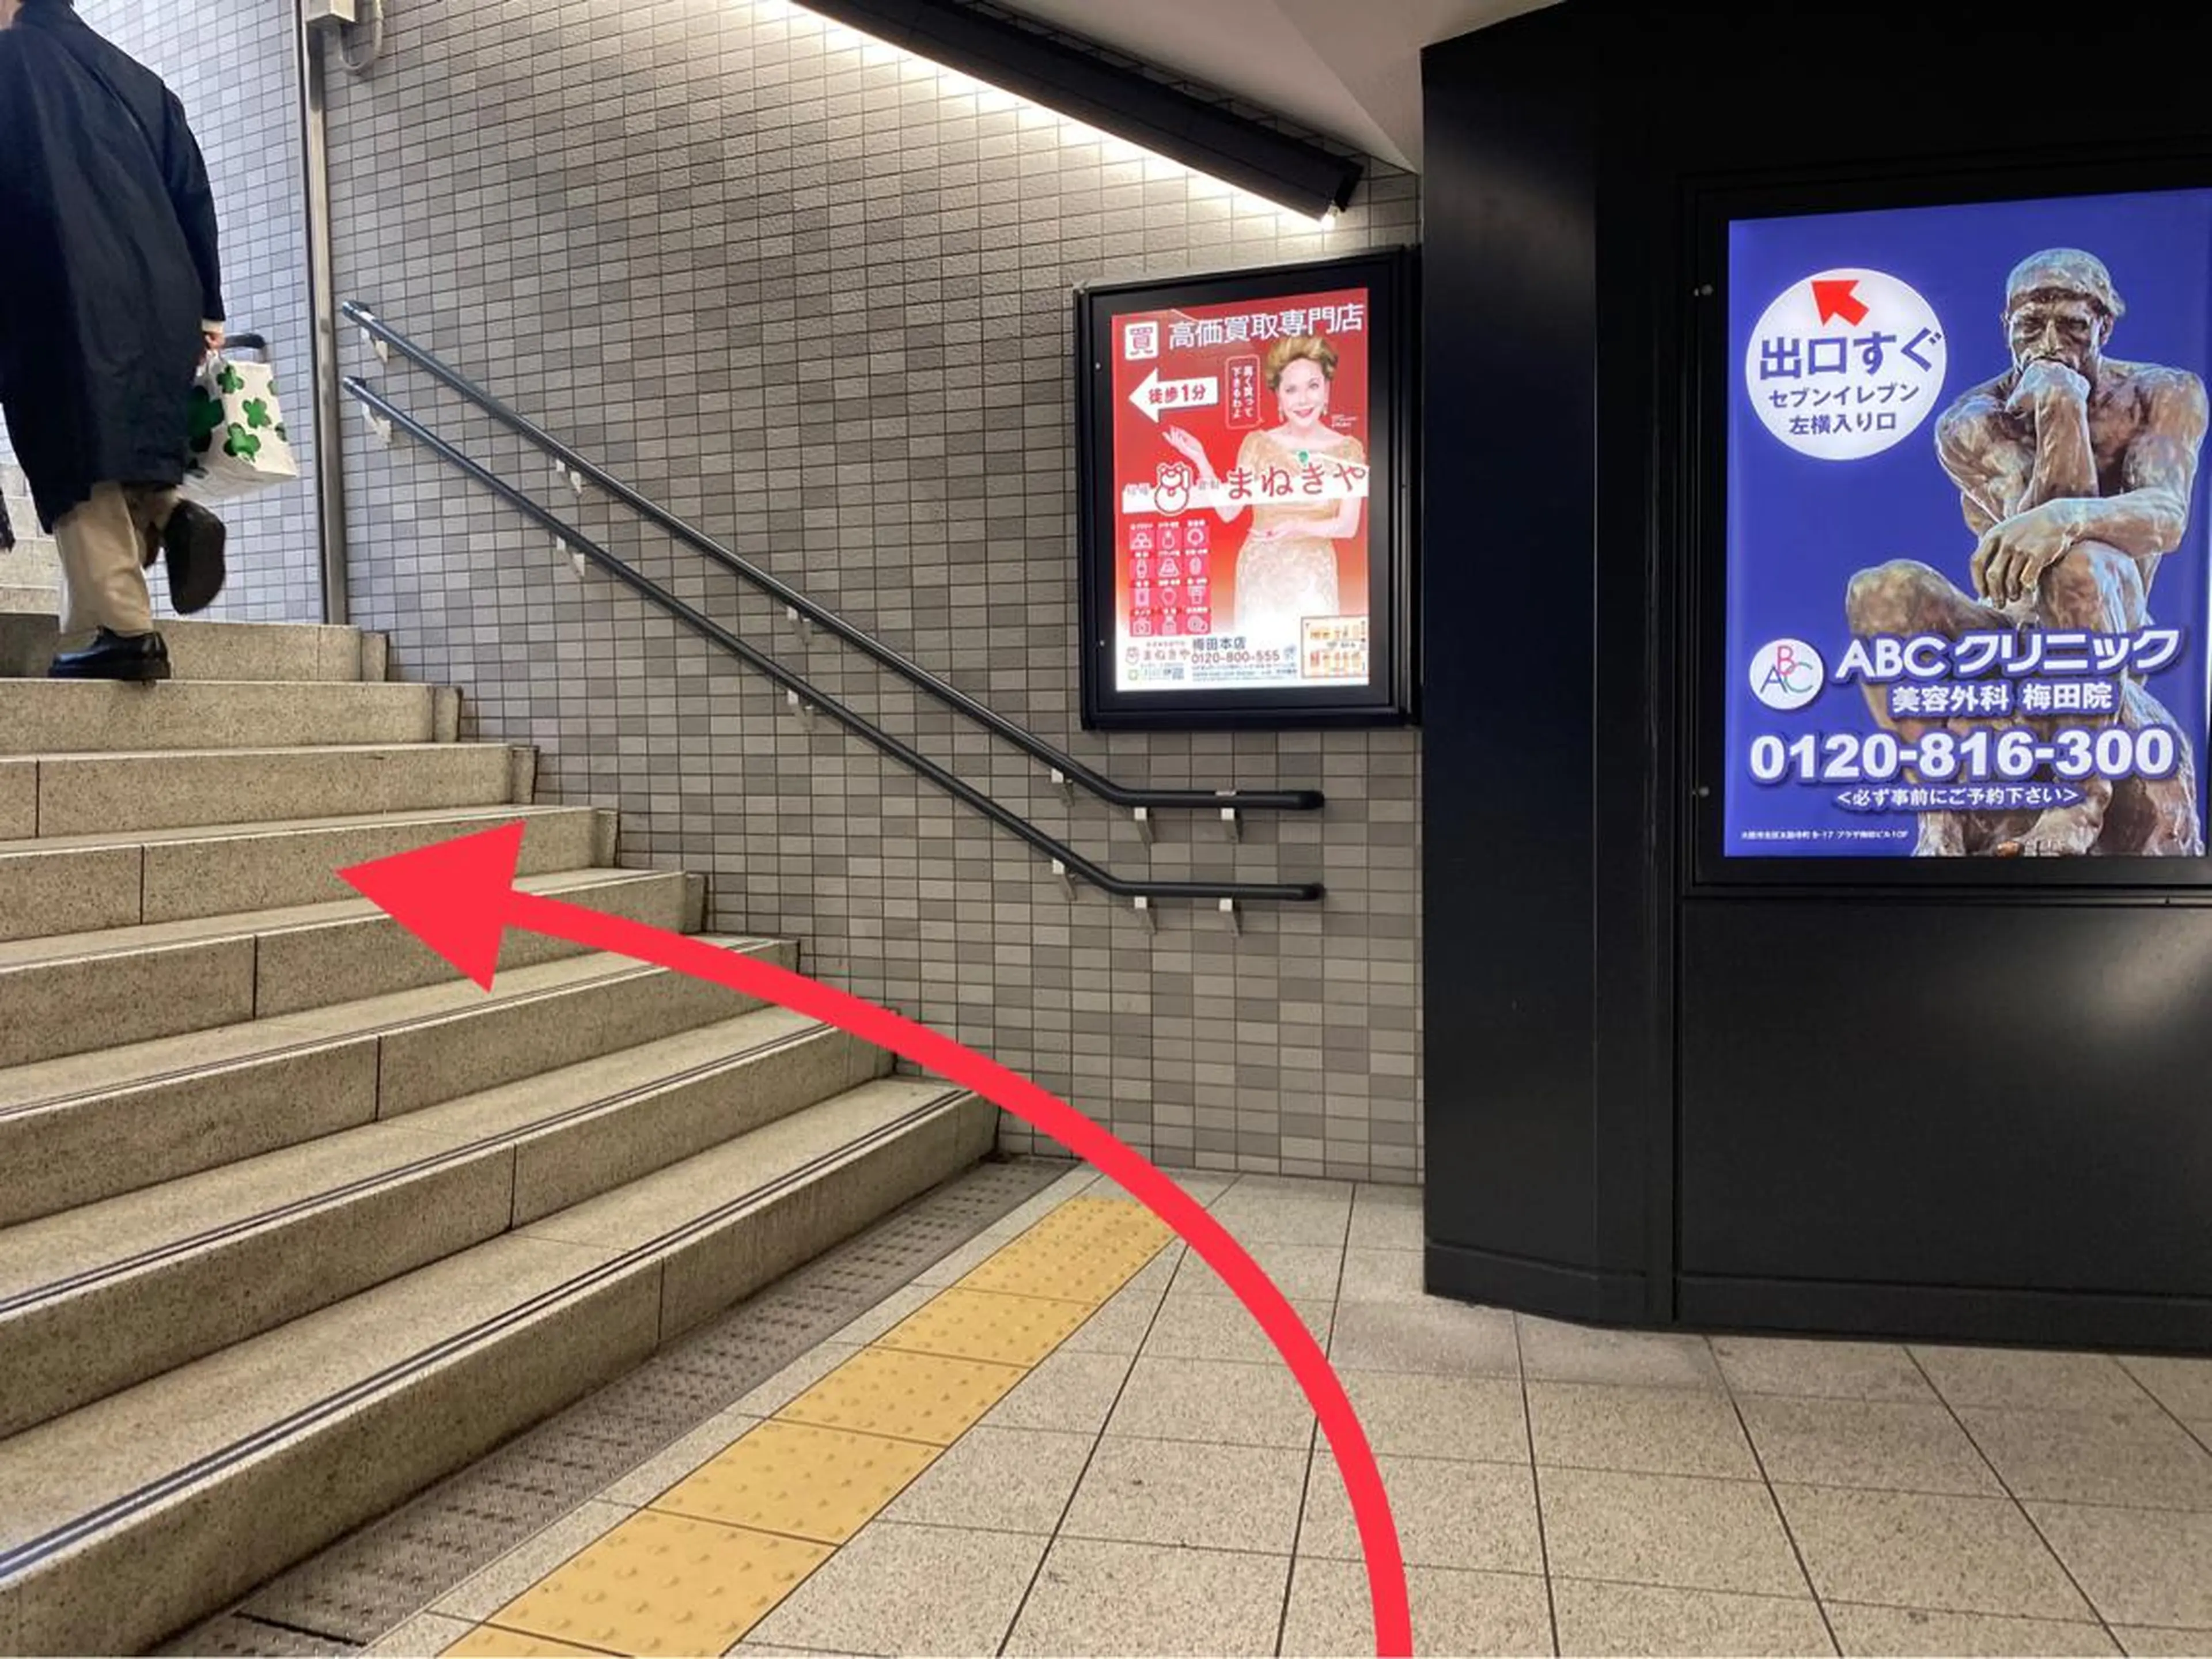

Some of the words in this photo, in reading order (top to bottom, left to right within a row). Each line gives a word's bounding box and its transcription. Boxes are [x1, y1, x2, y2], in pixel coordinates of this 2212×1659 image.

[1130, 326, 1154, 355] 買
[1168, 303, 1363, 350] 高価買取専門店
[1760, 327, 1942, 380] 出口すぐ
[1148, 384, 1206, 404] 徒歩1分
[1769, 382, 1919, 408] セブンイレブン
[1789, 412, 1896, 435] 左横入り口
[1229, 463, 1366, 499] まねきや
[1892, 683, 2009, 713] 美容外科
[2022, 681, 2113, 711] 梅田院
[1750, 729, 2175, 780] 0120-816-300
